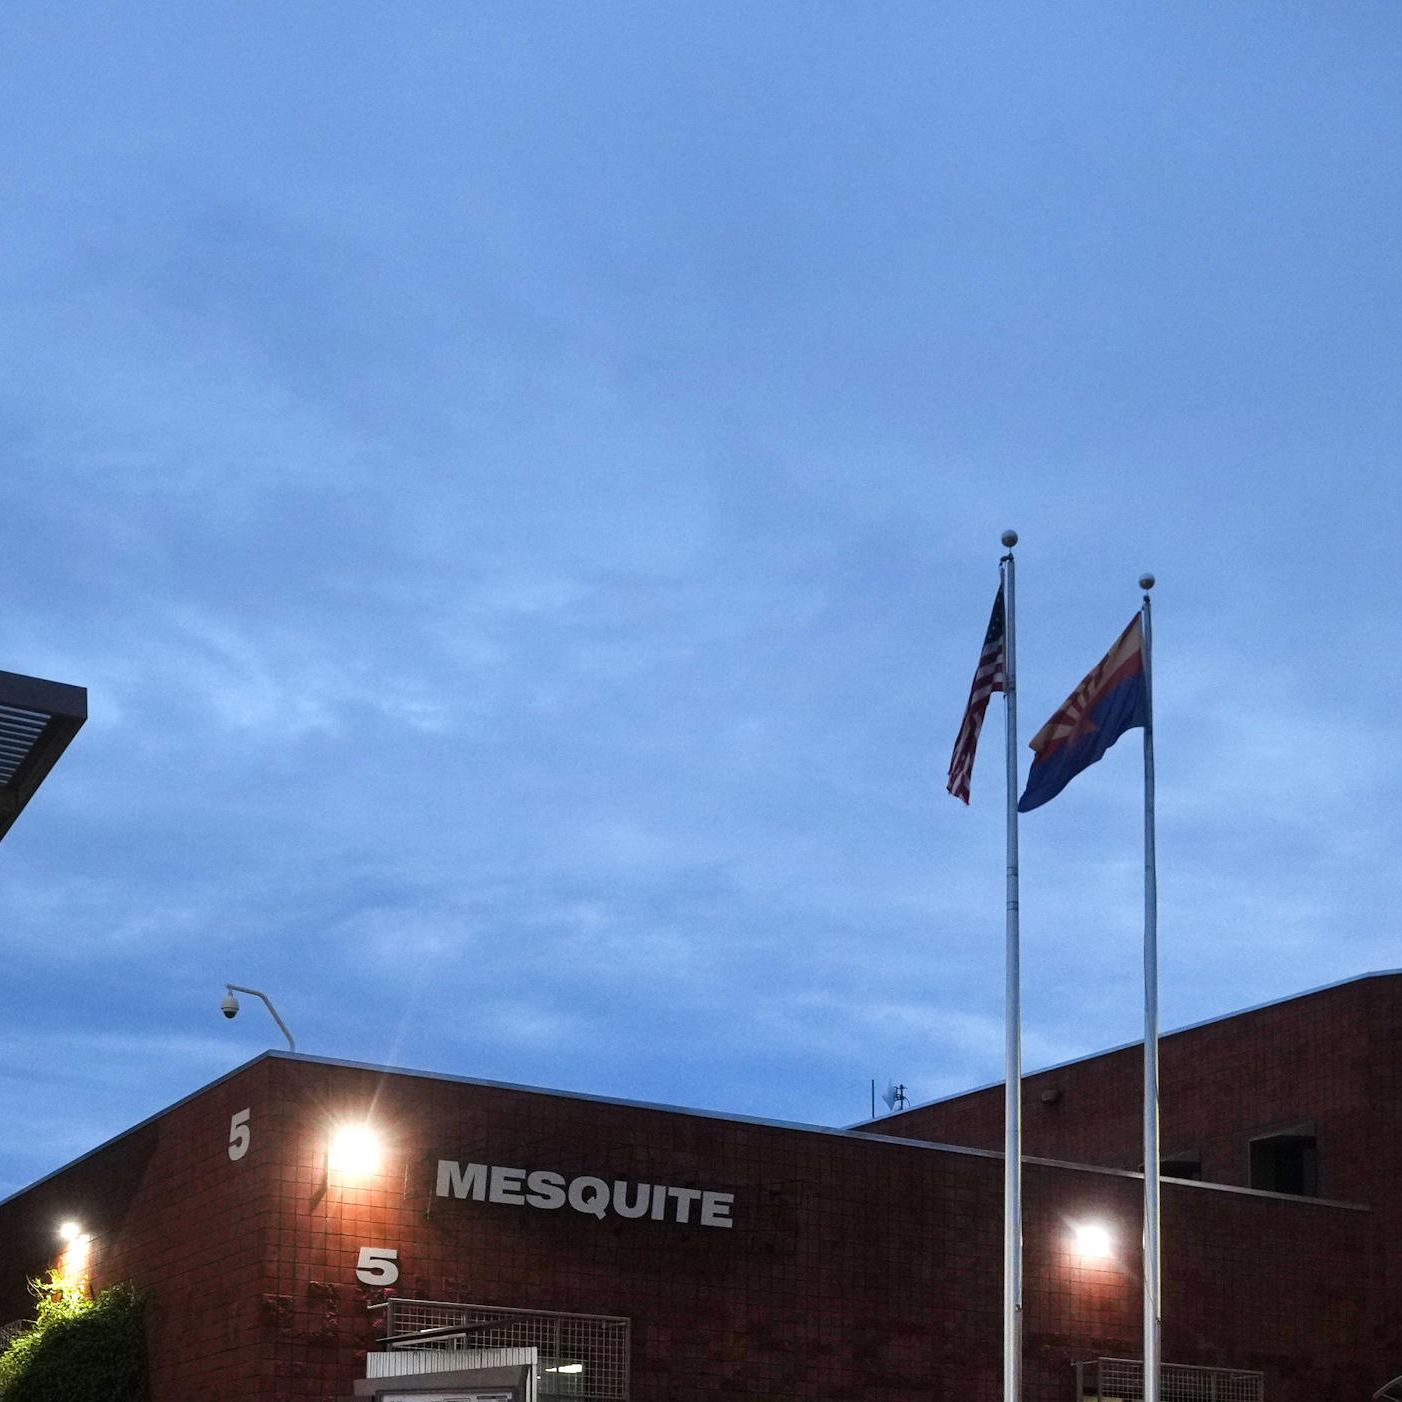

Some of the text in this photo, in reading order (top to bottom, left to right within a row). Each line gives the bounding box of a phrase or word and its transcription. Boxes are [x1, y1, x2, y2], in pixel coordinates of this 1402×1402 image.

[227, 1108, 251, 1162] 5
[435, 1159, 735, 1229] MESQUITE
[355, 1246, 399, 1286] 5
